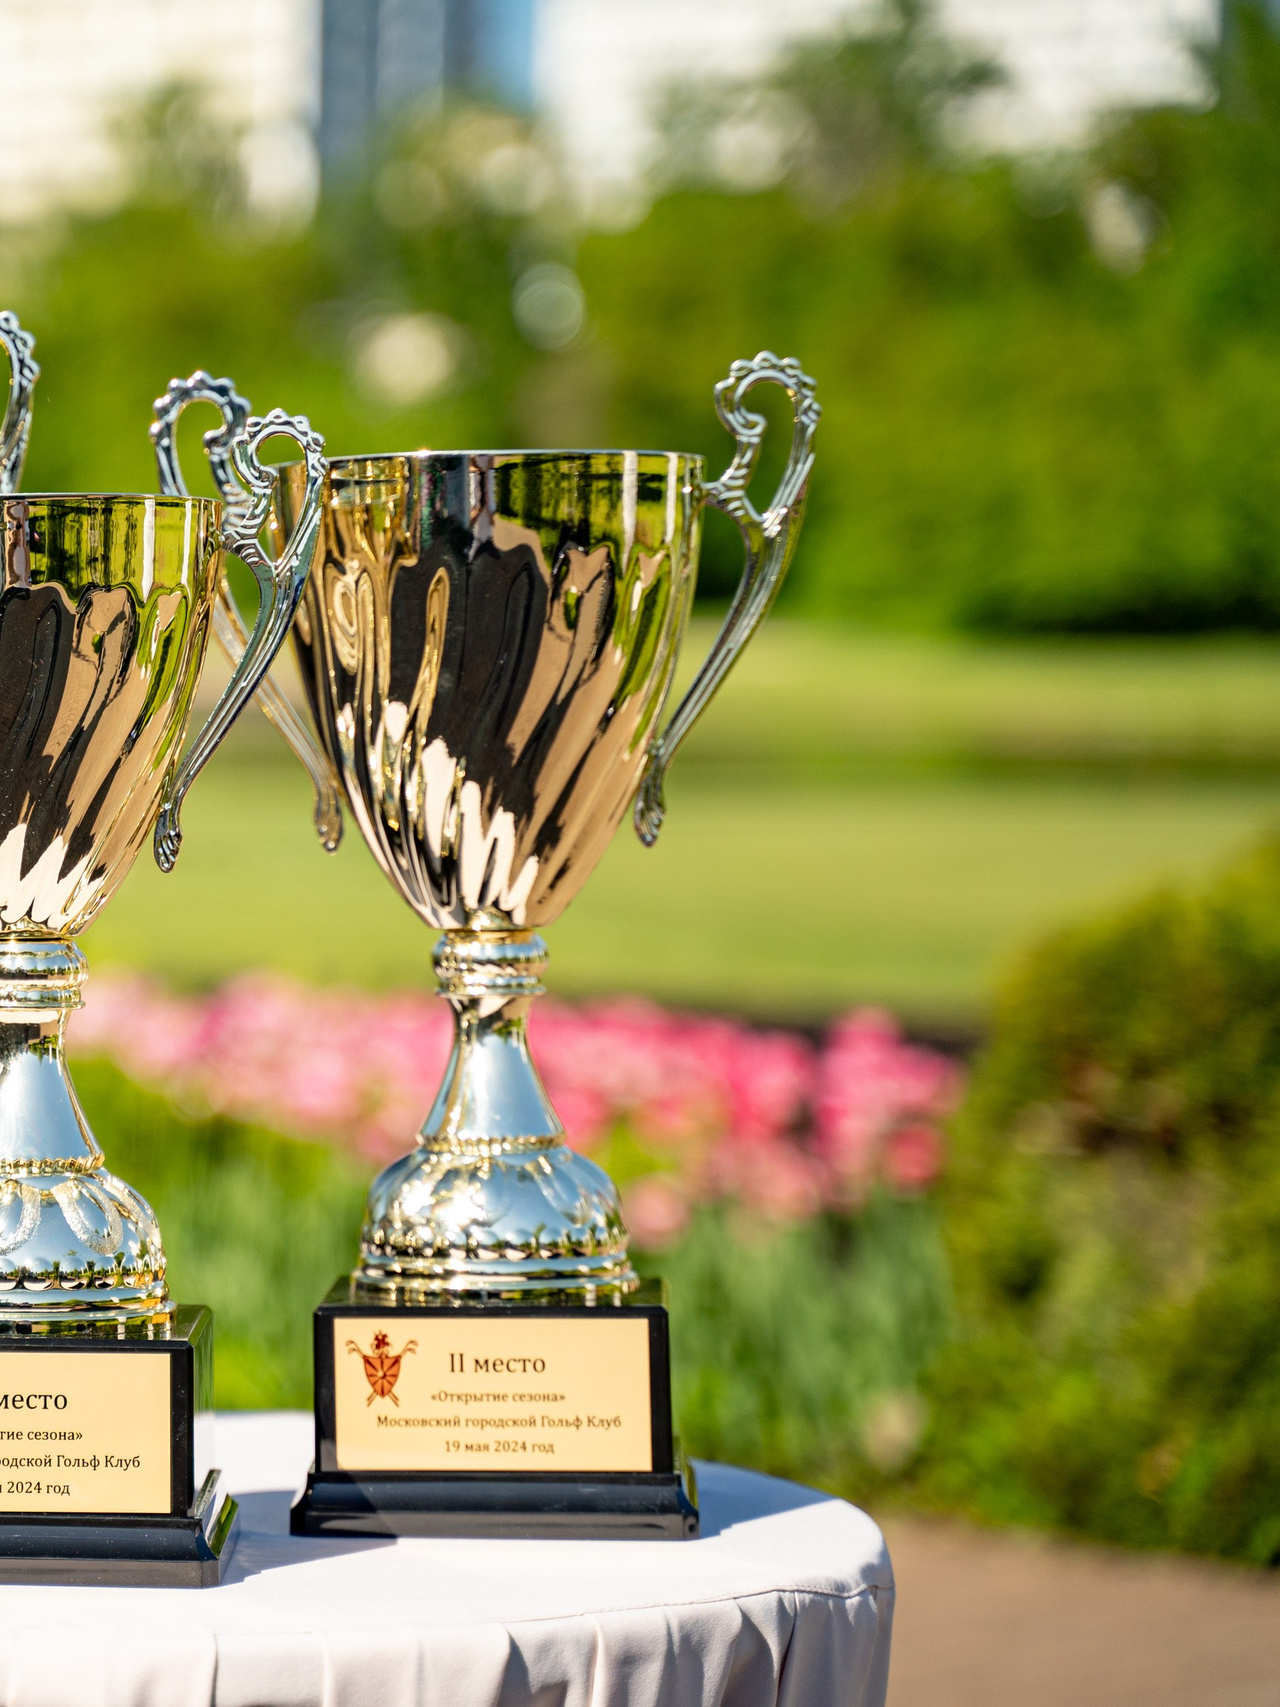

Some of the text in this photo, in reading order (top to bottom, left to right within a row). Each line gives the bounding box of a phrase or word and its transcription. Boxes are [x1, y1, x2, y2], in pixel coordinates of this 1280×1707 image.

[450, 1353, 546, 1373] II место
[430, 1390, 566, 1406] «Открытие сезона»
[376, 1414, 622, 1431] Московский городской Гольф Клуб
[26, 1431, 83, 1441] сезона»
[445, 1439, 556, 1455] 19 мая 2024 год
[56, 1454, 101, 1471] Гольф
[104, 1455, 141, 1472] Клуб
[7, 1480, 43, 1494] 2024
[46, 1484, 71, 1497] год
